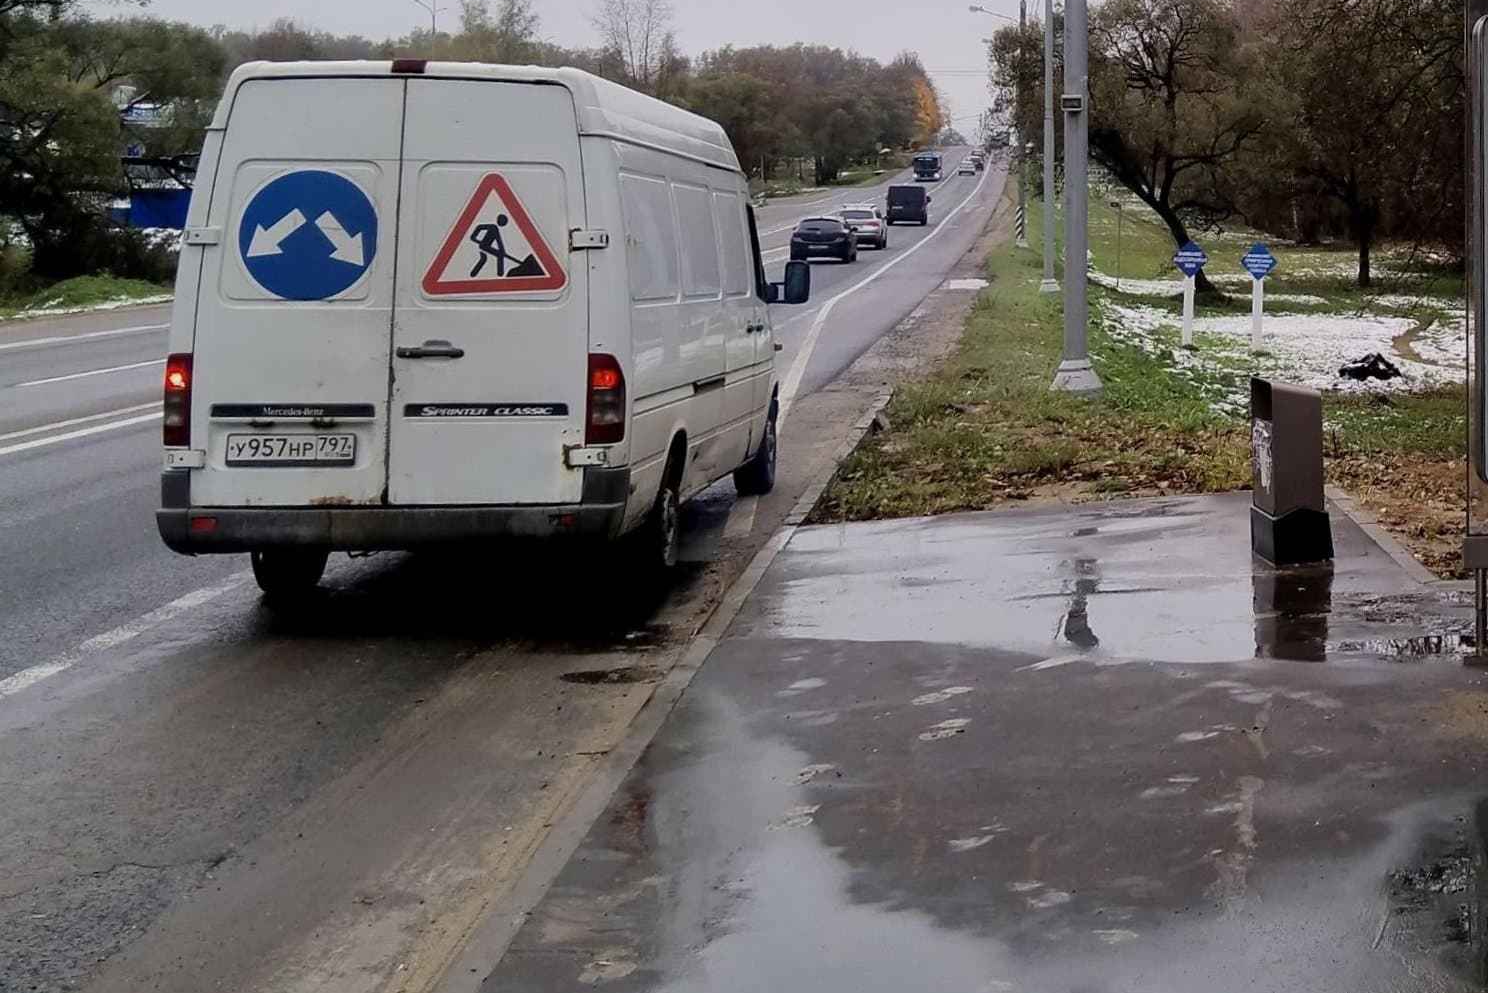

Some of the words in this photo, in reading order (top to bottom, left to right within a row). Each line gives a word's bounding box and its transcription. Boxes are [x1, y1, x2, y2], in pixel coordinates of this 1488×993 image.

[261, 406, 325, 417] Mercedes-Benz
[494, 406, 553, 416] CLASSIC
[318, 436, 350, 452] 797
